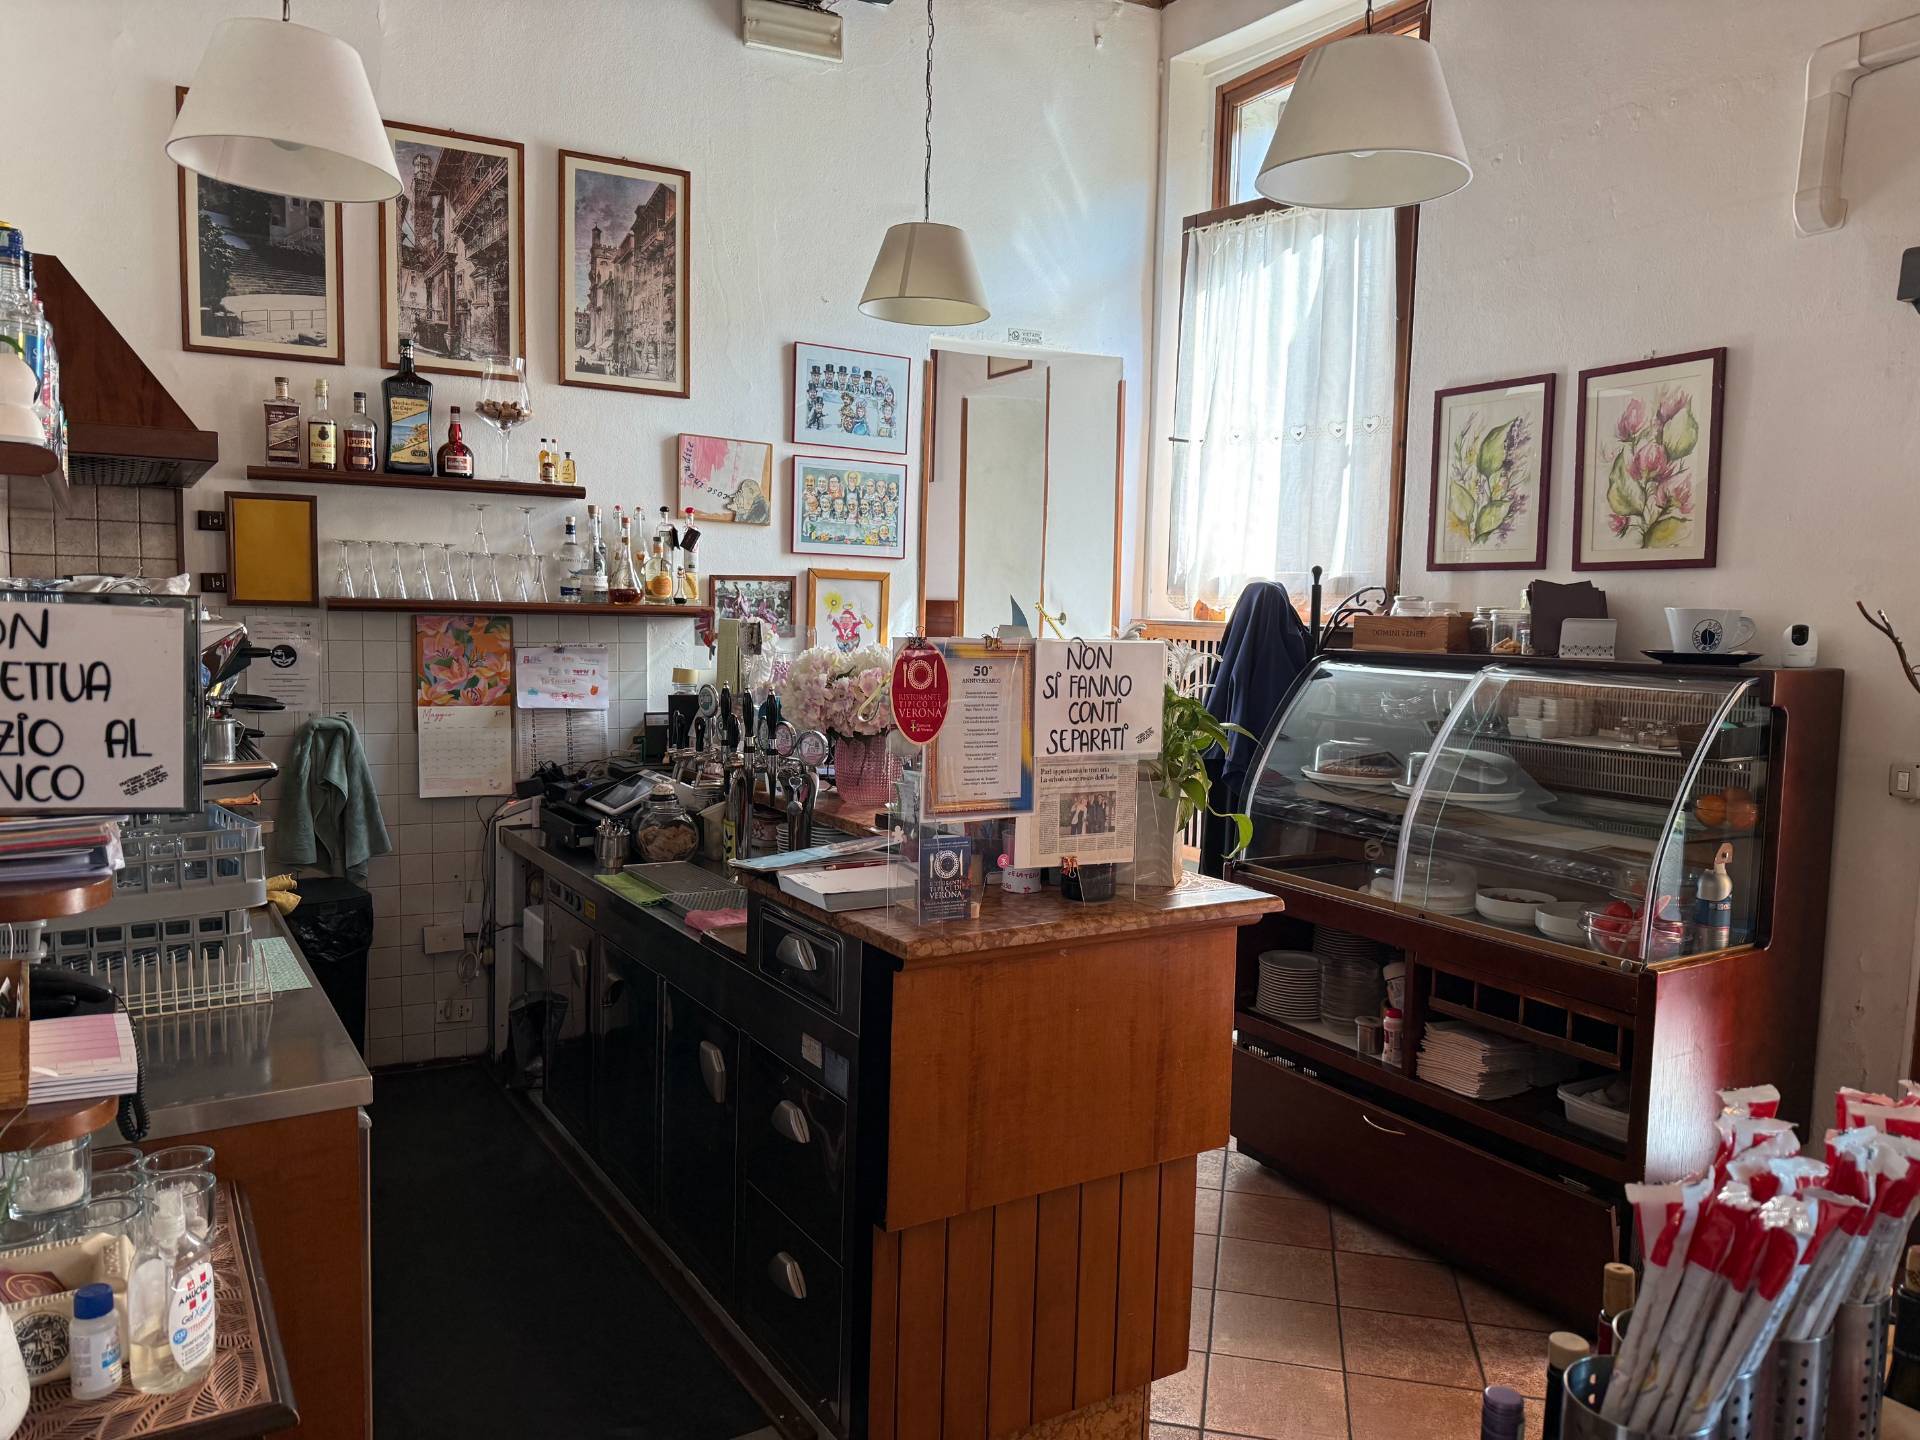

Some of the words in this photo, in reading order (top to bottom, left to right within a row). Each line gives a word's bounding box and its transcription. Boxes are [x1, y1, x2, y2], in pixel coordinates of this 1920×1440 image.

[707, 487, 727, 499] cose
[1067, 645, 1112, 670] NON
[1043, 672, 1062, 699] SI
[1070, 674, 1132, 698] FANNO
[898, 708, 942, 718] VERONA
[1069, 698, 1122, 724] CONTI
[104, 717, 152, 758] AL
[1046, 723, 1129, 754] SEPARATI
[929, 891, 962, 899] VERONA
[182, 1313, 194, 1325] Gel
